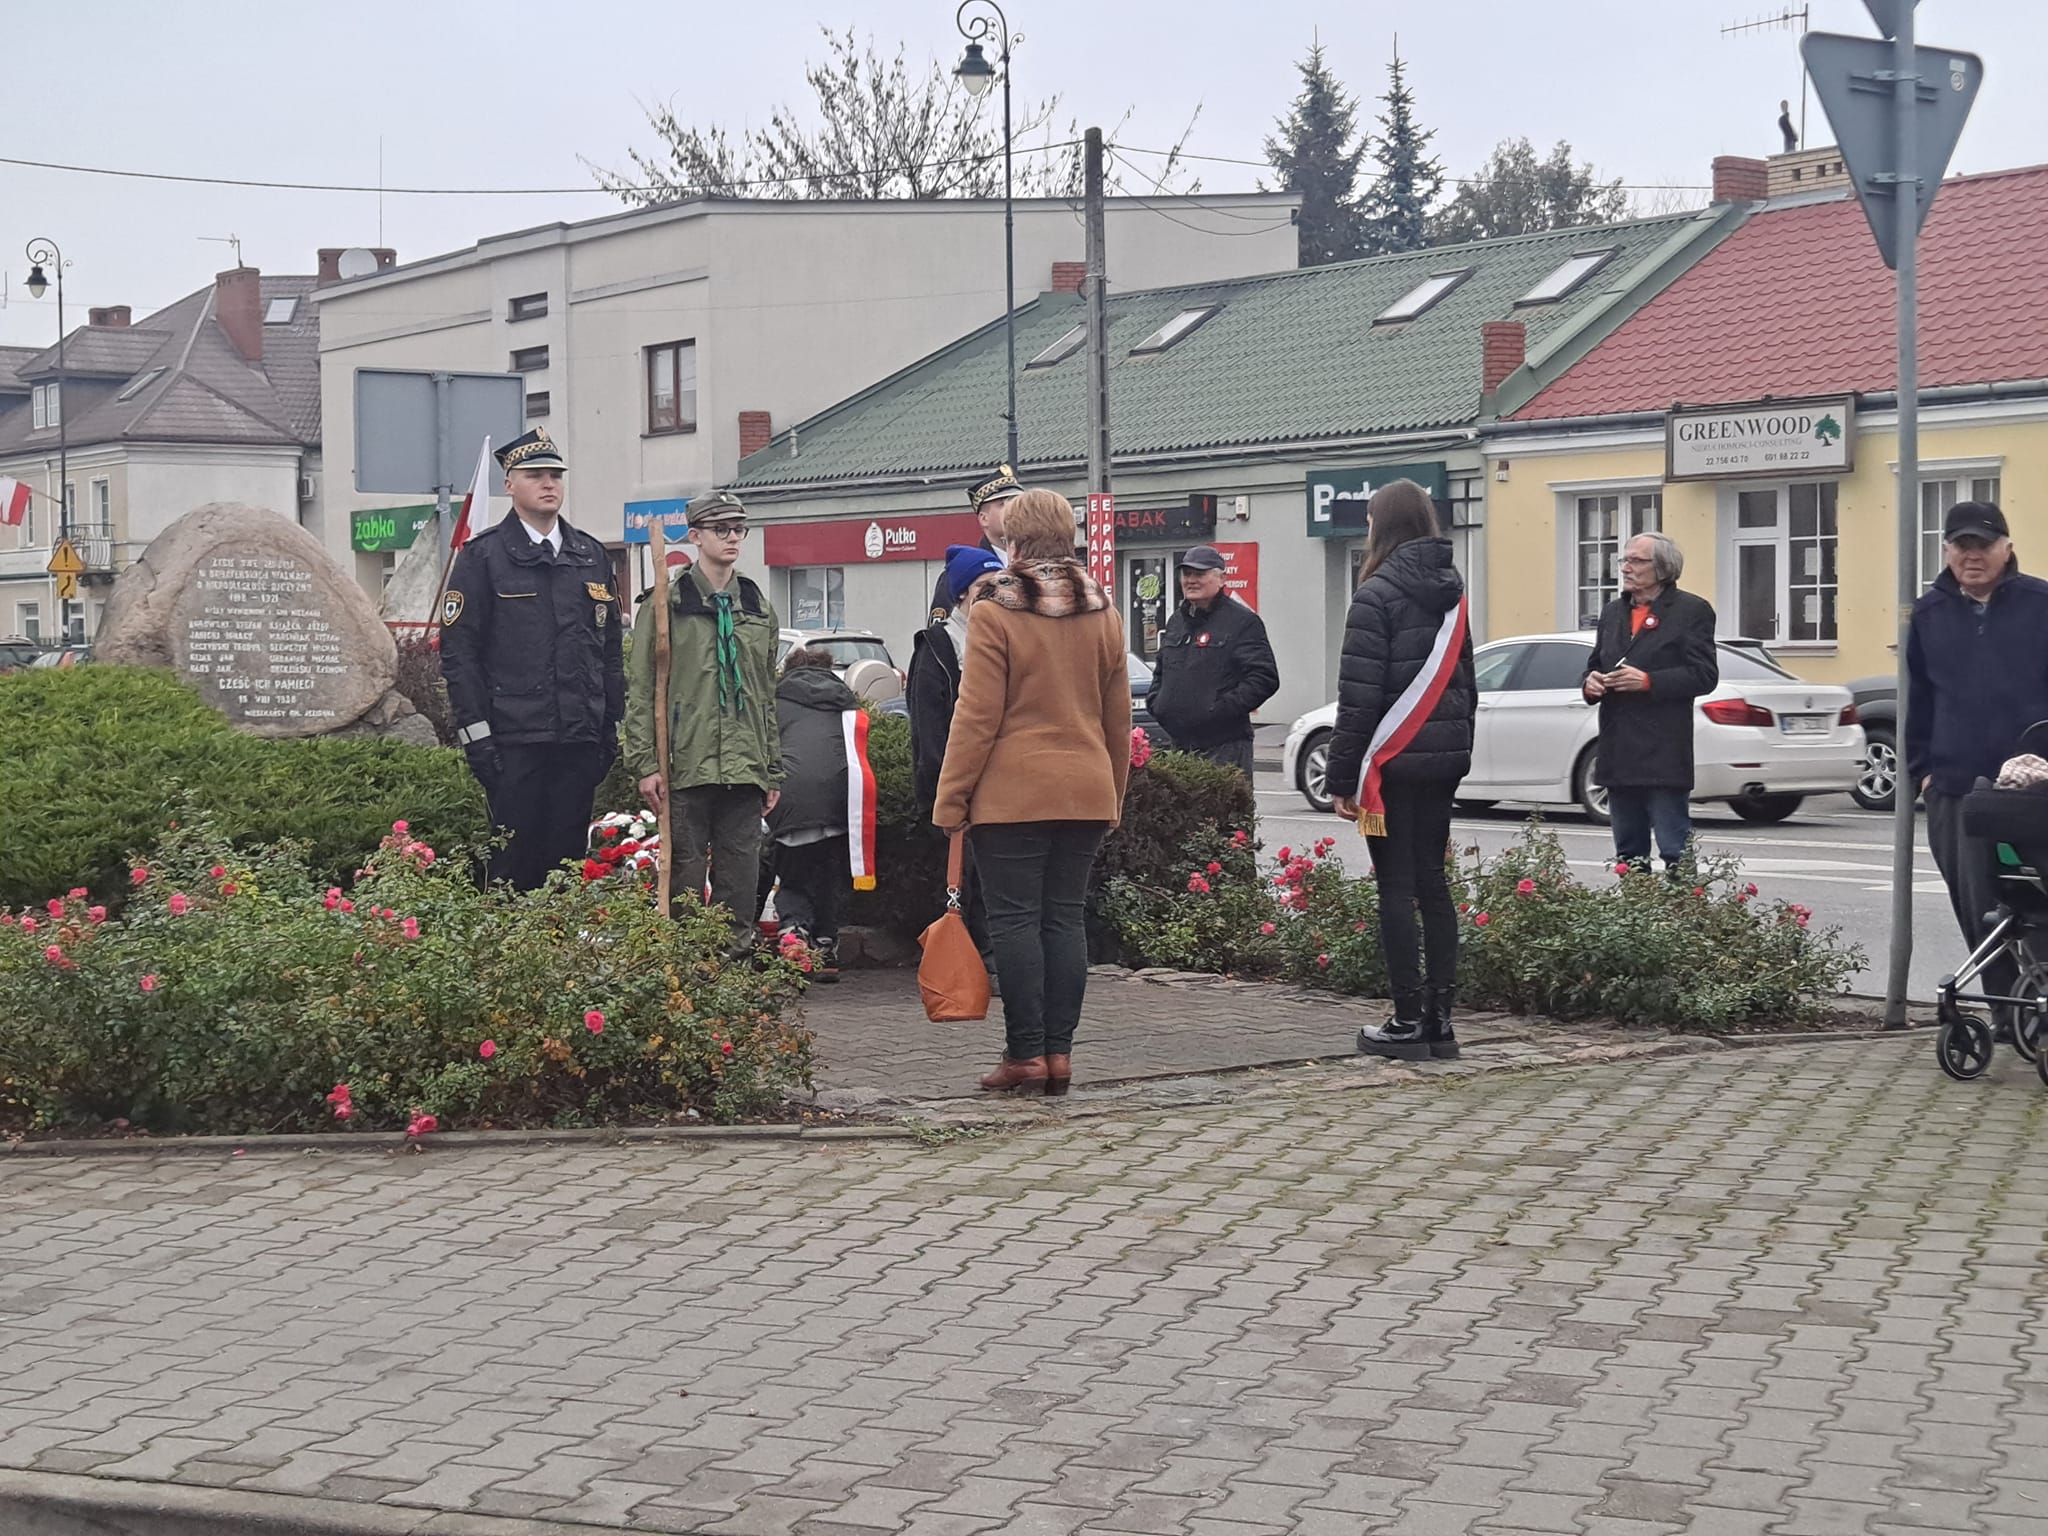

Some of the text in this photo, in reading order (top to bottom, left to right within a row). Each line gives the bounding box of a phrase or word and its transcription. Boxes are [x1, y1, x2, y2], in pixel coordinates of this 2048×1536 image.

[1679, 416, 1811, 442] GREENWOOD
[355, 515, 395, 540] żabka
[1114, 511, 1166, 528] ABAK
[885, 527, 916, 545] Putka
[219, 676, 250, 690] CZEŚĆ
